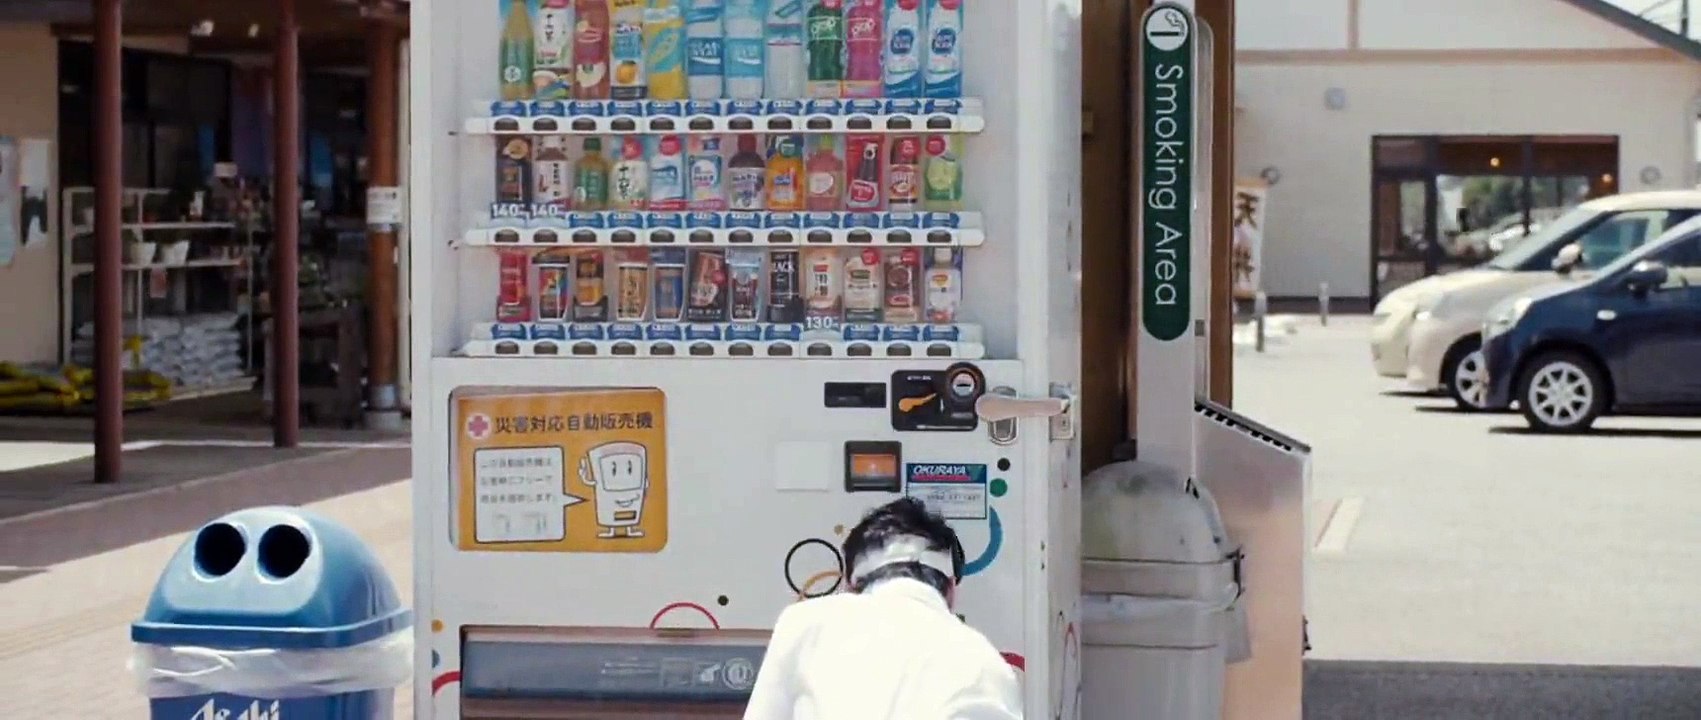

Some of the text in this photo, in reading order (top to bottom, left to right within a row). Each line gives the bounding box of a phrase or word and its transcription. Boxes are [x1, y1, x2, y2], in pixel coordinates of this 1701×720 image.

[1148, 64, 1184, 305] Smoking Area
[805, 316, 833, 329] 130
[495, 411, 654, 434] 災害対応自動販売機
[913, 465, 967, 475] OKURAYA
